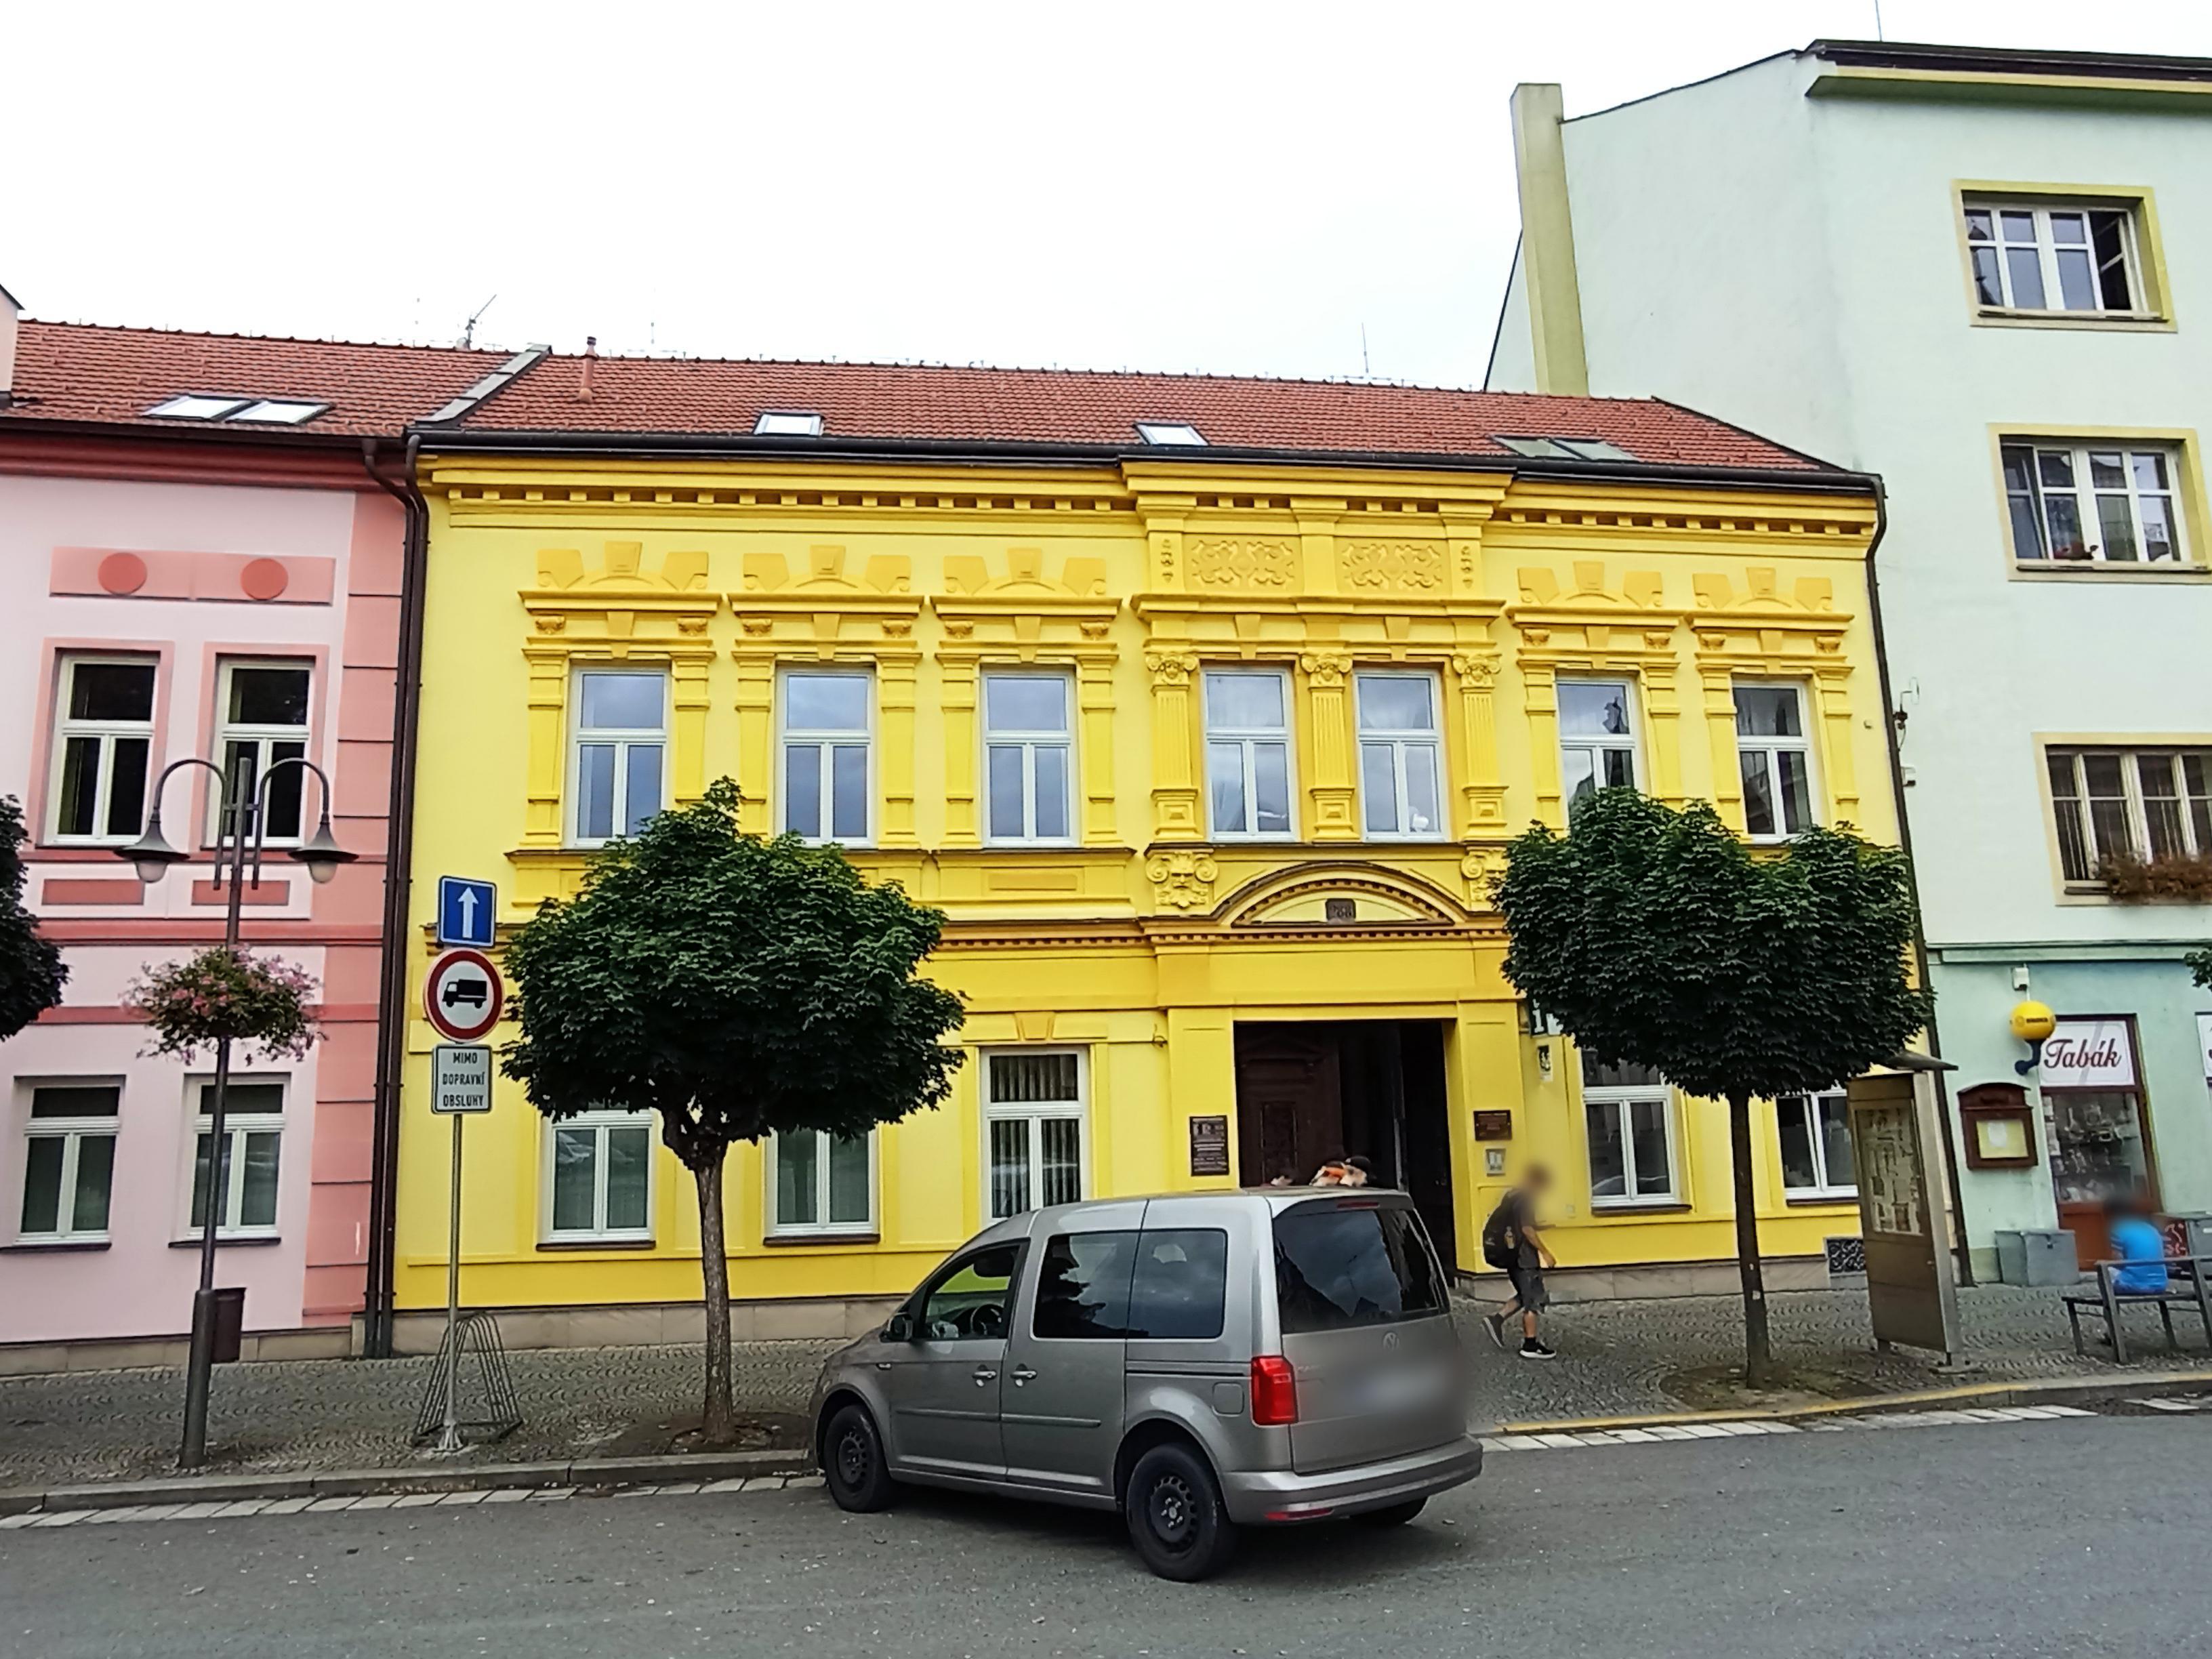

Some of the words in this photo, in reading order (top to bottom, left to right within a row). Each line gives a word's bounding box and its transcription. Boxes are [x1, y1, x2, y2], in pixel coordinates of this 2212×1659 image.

[453, 1052, 478, 1064] MIMO
[2044, 1038, 2122, 1069] Tabák
[443, 1071, 485, 1086] DOPRAVNÍ
[443, 1094, 484, 1107] OBSLUHY
